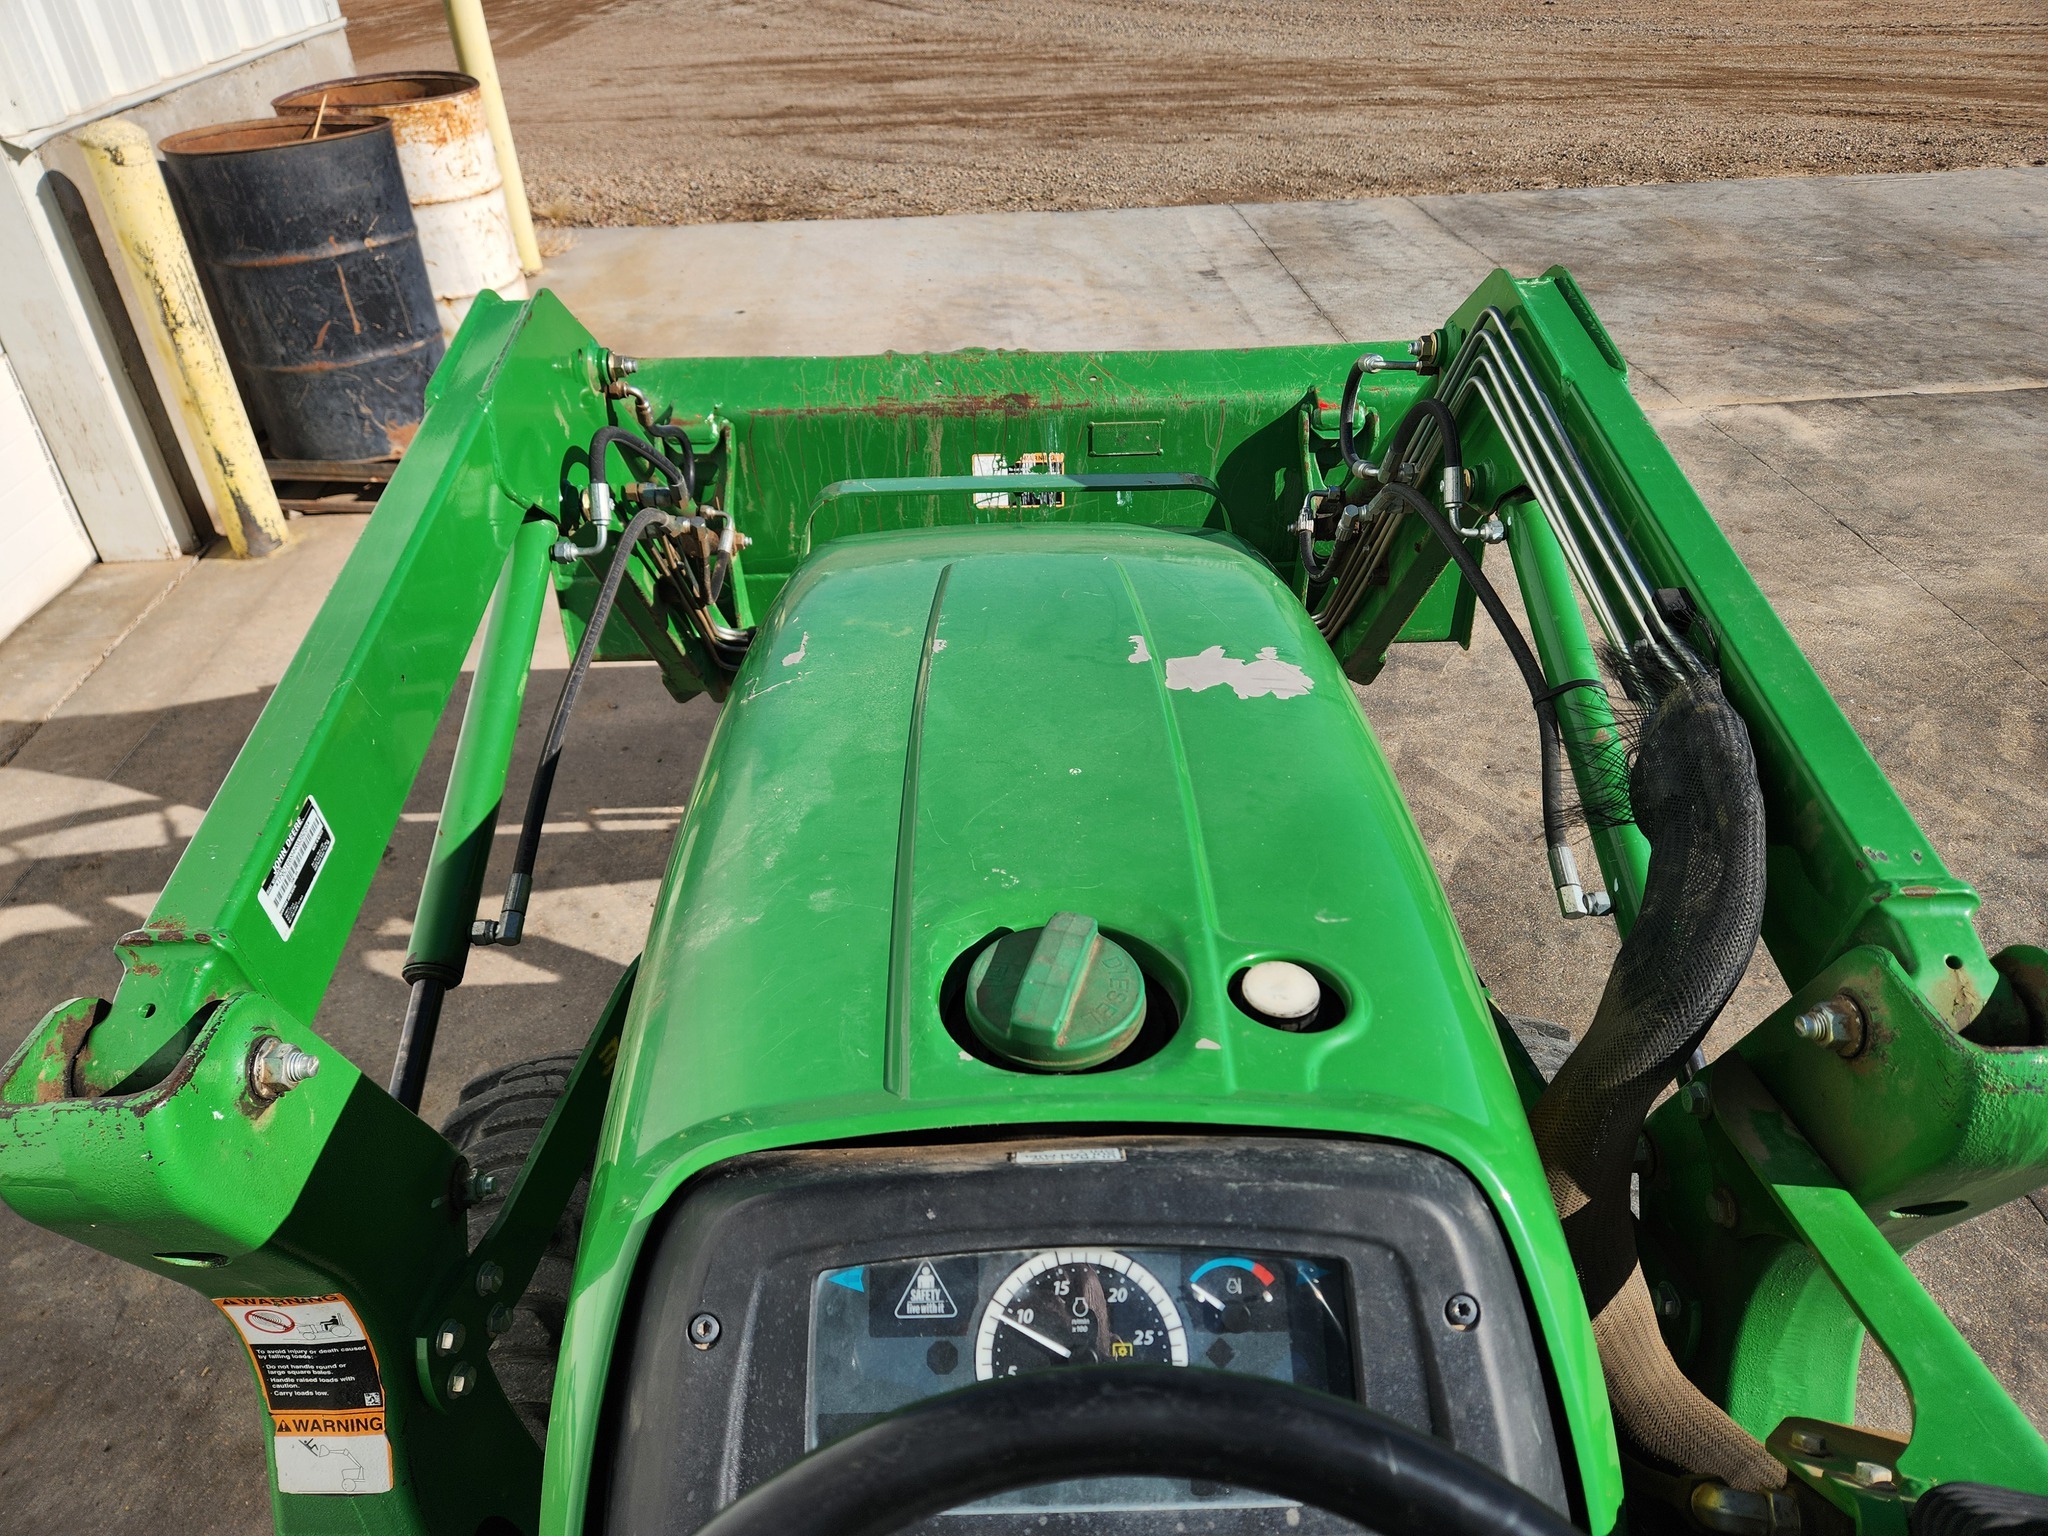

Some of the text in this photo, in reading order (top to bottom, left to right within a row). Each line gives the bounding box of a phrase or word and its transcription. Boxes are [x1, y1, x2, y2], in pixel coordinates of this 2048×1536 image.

[272, 847, 288, 874] JOHN
[285, 816, 303, 847] DEERE
[1080, 954, 1130, 1025] DIESEL
[910, 1288, 941, 1301] SAFETY
[1053, 1280, 1070, 1296] 15
[1107, 1287, 1128, 1303] 20
[237, 1294, 339, 1305] WARNING
[906, 1301, 945, 1314] live with it
[1016, 1308, 1034, 1324] 10
[1132, 1330, 1154, 1345] 25
[292, 1417, 383, 1432] WARNING
